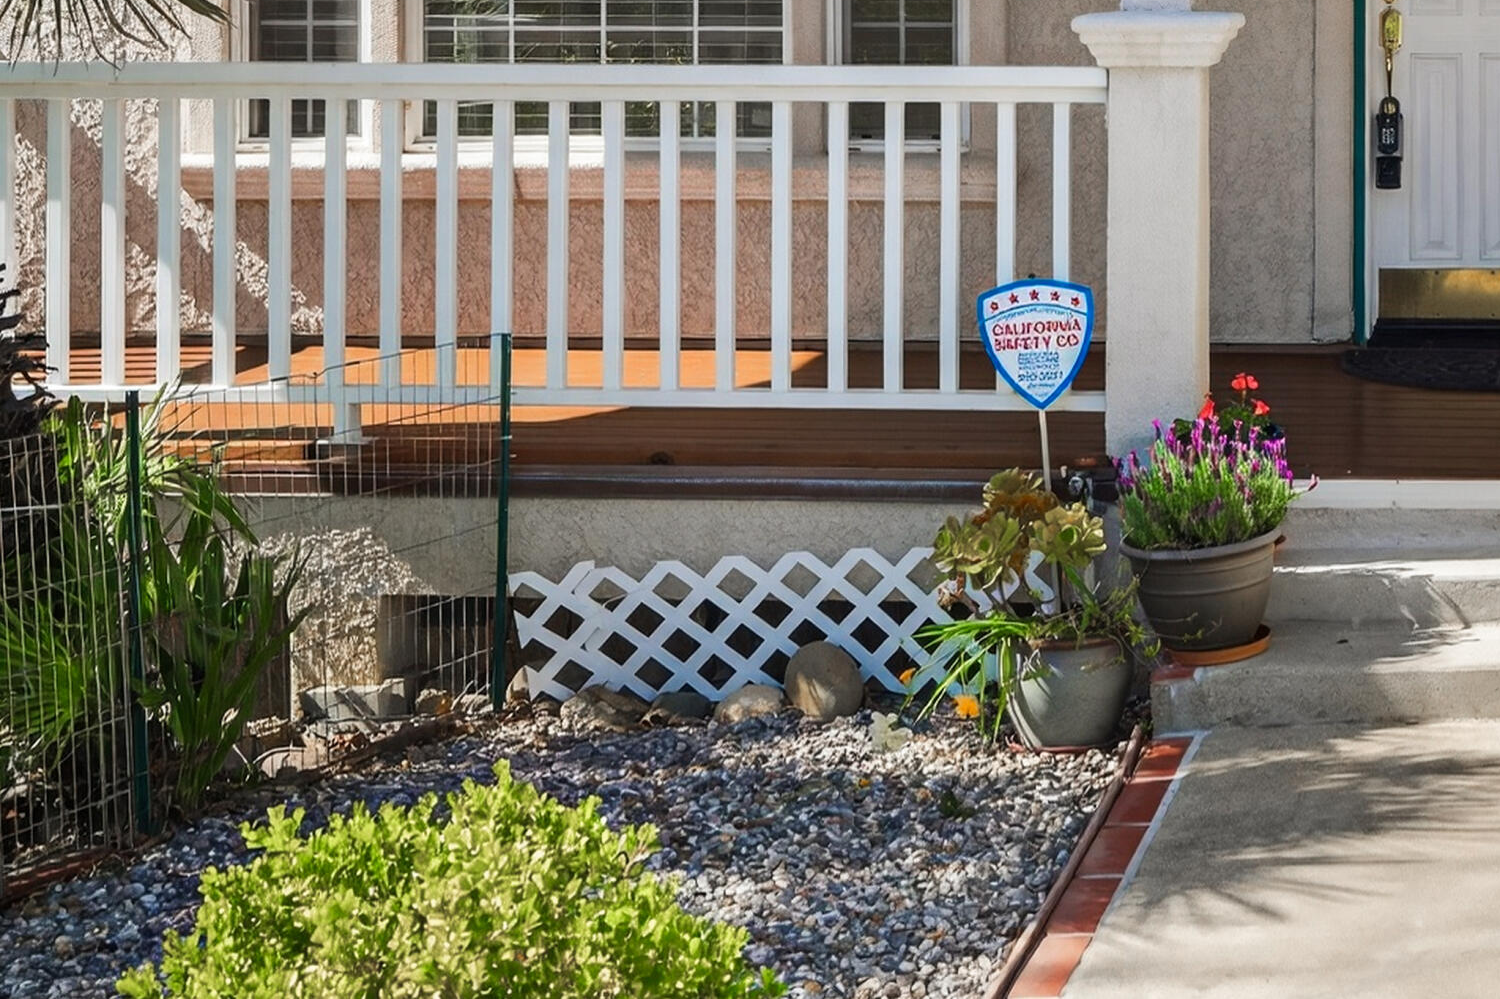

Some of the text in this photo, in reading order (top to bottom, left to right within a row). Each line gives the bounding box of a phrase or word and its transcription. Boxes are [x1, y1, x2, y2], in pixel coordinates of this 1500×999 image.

[992, 318, 1082, 336] CALIFORNIA
[994, 333, 1080, 352] SAFETY CO
